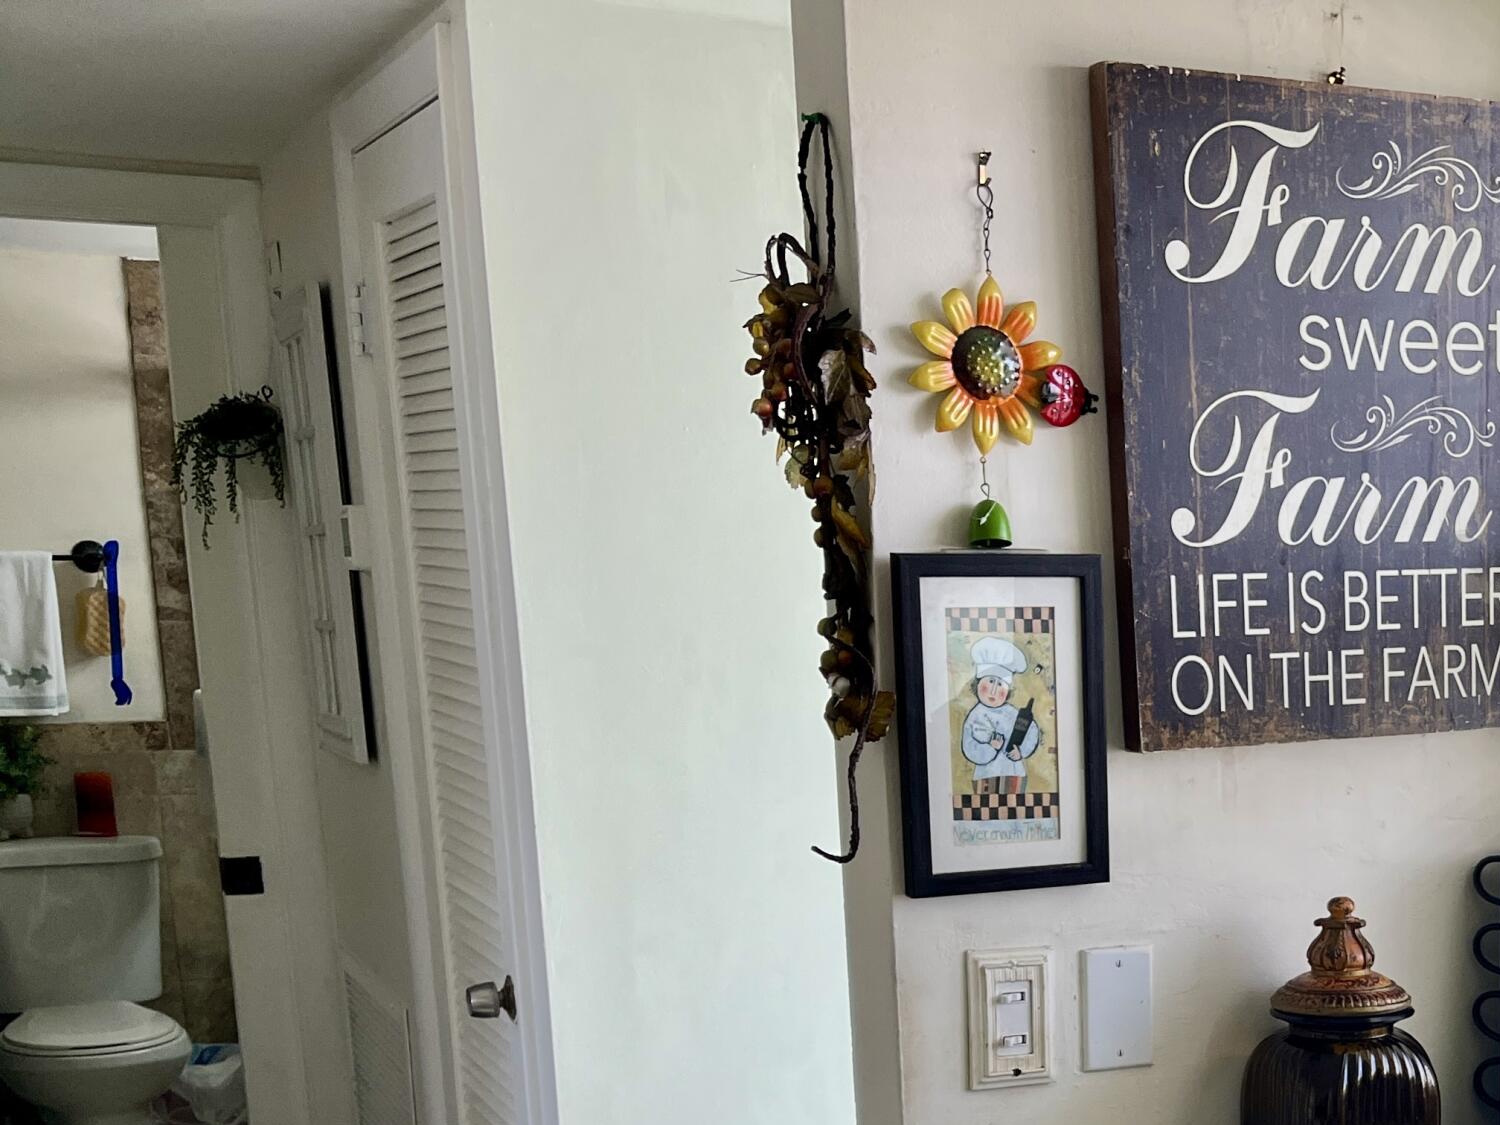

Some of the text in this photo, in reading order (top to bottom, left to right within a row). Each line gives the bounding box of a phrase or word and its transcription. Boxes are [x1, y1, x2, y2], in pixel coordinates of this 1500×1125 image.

[1164, 120, 1496, 296] Farm
[1170, 389, 1493, 547] Farm
[1170, 571, 1268, 639] LIFE
[1288, 569, 1327, 635] IS
[1171, 652, 1254, 716] ON
[1270, 648, 1366, 709] THE
